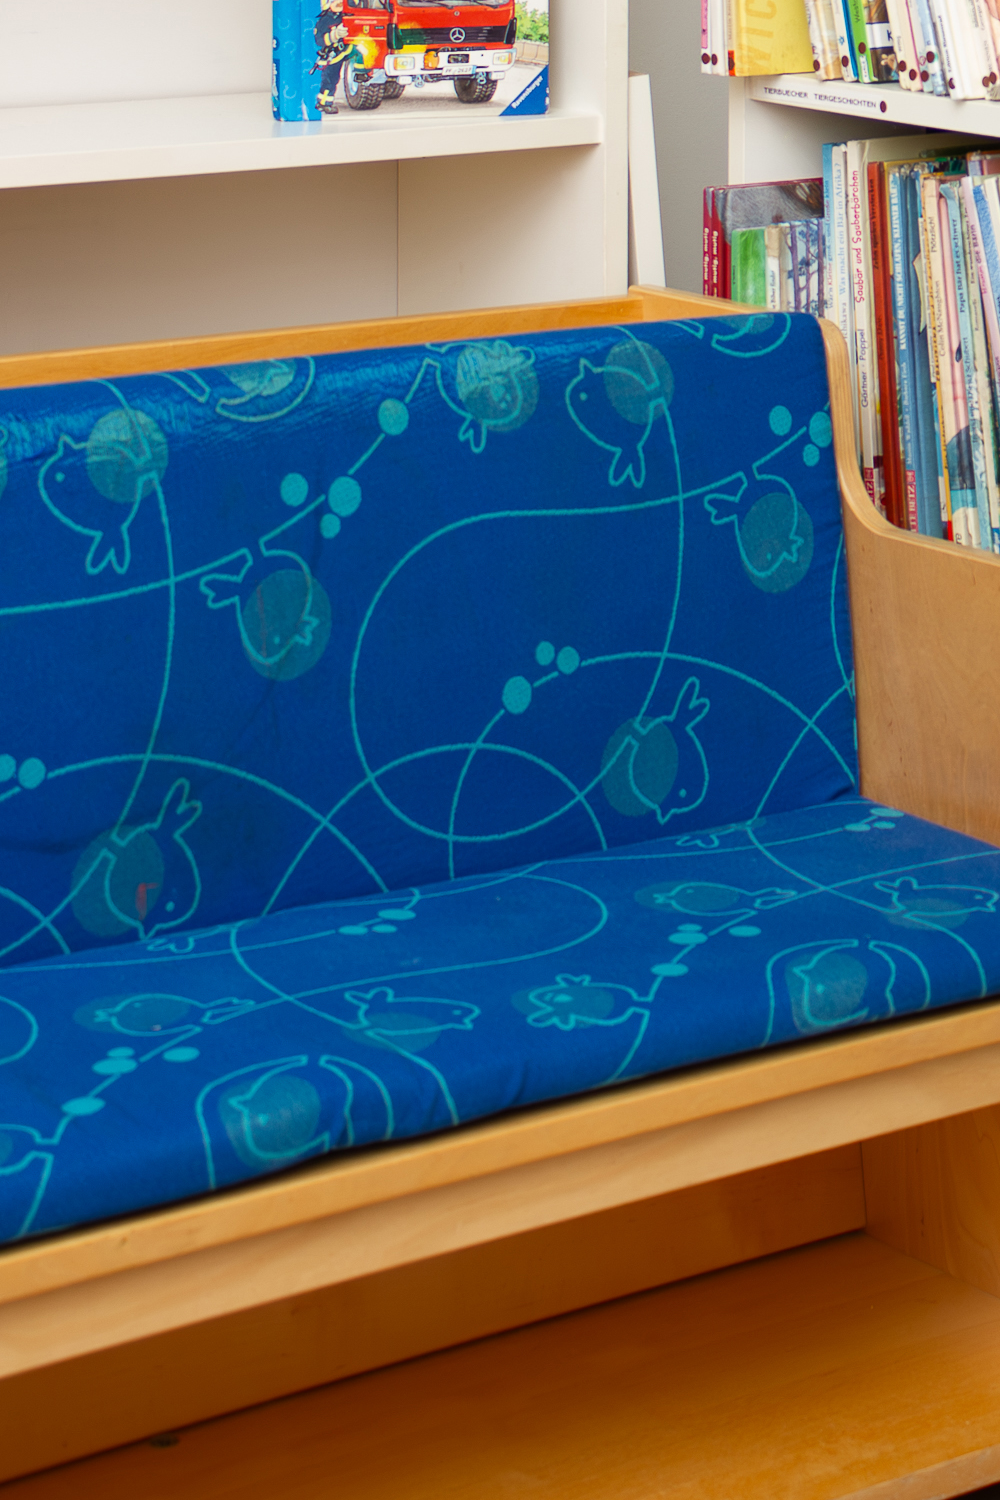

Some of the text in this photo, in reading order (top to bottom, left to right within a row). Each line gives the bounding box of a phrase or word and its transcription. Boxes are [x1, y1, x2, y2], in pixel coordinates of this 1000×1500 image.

[763, 86, 877, 109] TIERBUECHER TIERGESCHICHTEN
[850, 170, 864, 302] Saubär und Sauberbärchen
